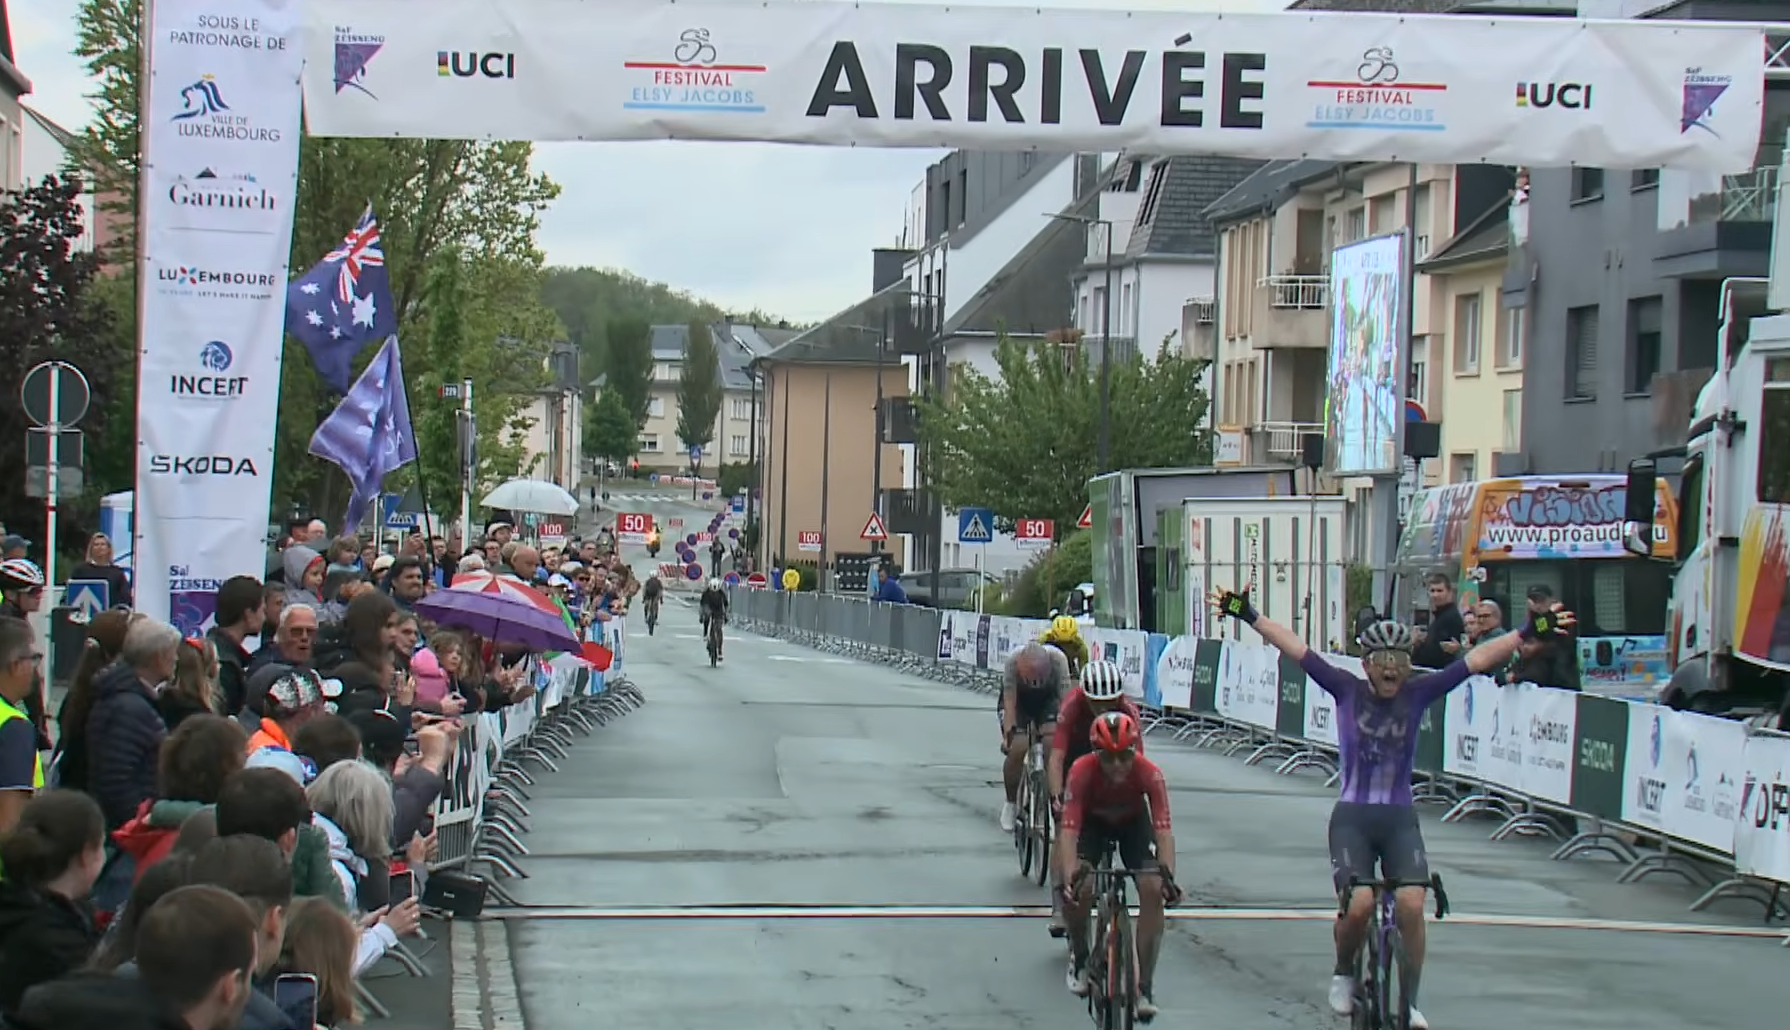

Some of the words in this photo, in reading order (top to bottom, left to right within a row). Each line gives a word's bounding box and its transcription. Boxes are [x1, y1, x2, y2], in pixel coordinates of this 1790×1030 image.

[198, 15, 239, 29] SOUS
[244, 17, 259, 31] LE
[170, 31, 261, 49] PATRONAGE
[267, 37, 286, 50] DE
[654, 70, 733, 87] FESTIVAL
[805, 32, 1266, 129] ARRIVÉE
[632, 87, 672, 103] ELSY
[680, 88, 754, 105] JACOBS
[1337, 89, 1413, 105] FESTIVAL
[212, 115, 234, 125] VILLE
[236, 116, 248, 126] DE
[1315, 106, 1354, 121] ELSY
[1361, 107, 1434, 122] JACOBS
[178, 122, 281, 142] LUXEMBOURG
[169, 182, 275, 210] Garnich
[544, 524, 562, 534] 100
[625, 514, 644, 531] 50
[1026, 521, 1045, 537] 50
[801, 532, 820, 543] 100
